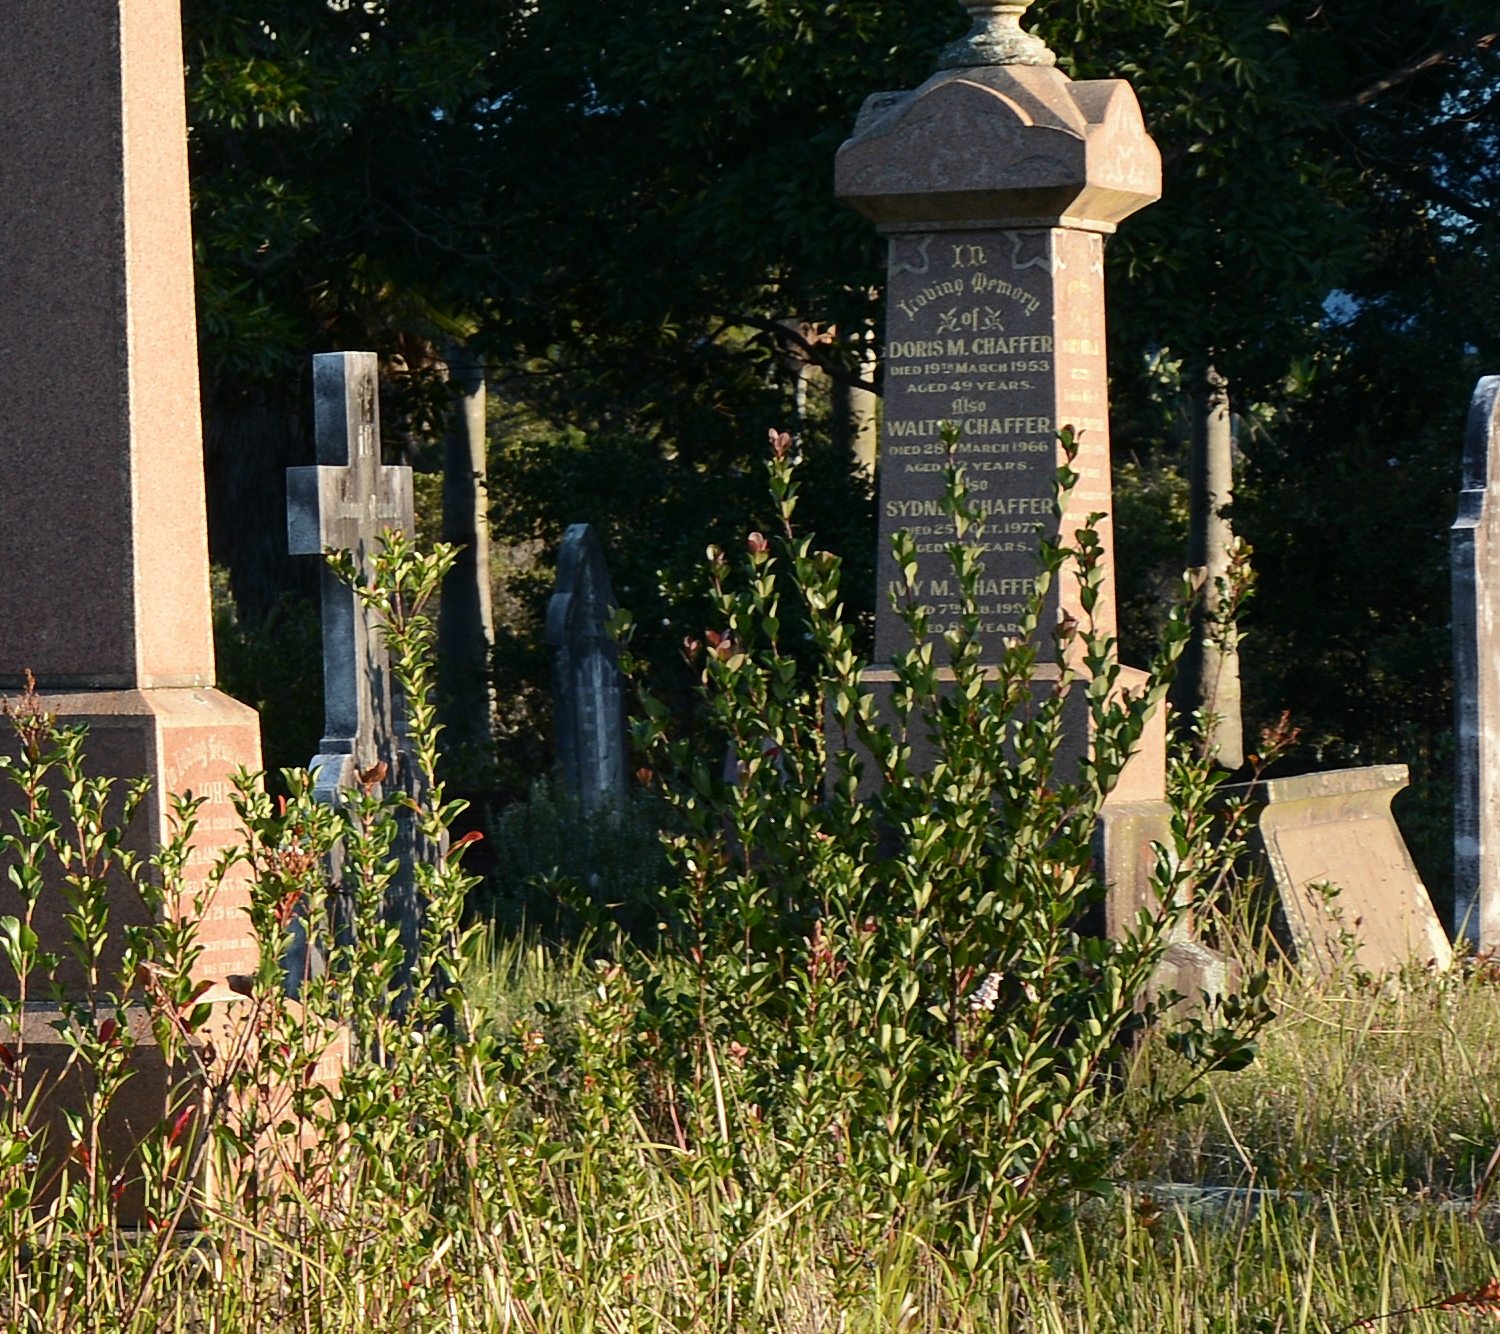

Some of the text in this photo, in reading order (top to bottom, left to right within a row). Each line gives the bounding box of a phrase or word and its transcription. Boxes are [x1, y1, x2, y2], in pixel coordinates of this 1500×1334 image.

[897, 271, 1040, 321] Loving Memory
[961, 307, 980, 332] of
[890, 339, 944, 359] DORIS
[947, 338, 970, 356] M.
[972, 335, 1053, 355] CHAFFER
[890, 365, 922, 376] DIED
[1011, 360, 1050, 372] 1953
[906, 380, 1036, 394] AGED 49 YEARS.
[950, 397, 987, 415] Also
[964, 417, 1051, 436] CHAFFER
[889, 445, 921, 456] DIED
[1012, 440, 1049, 452] 1966
[904, 462, 941, 473] AGED
[972, 460, 1034, 471] YEARS.
[968, 498, 1054, 515] CHAFFER
[930, 579, 955, 597] M.
